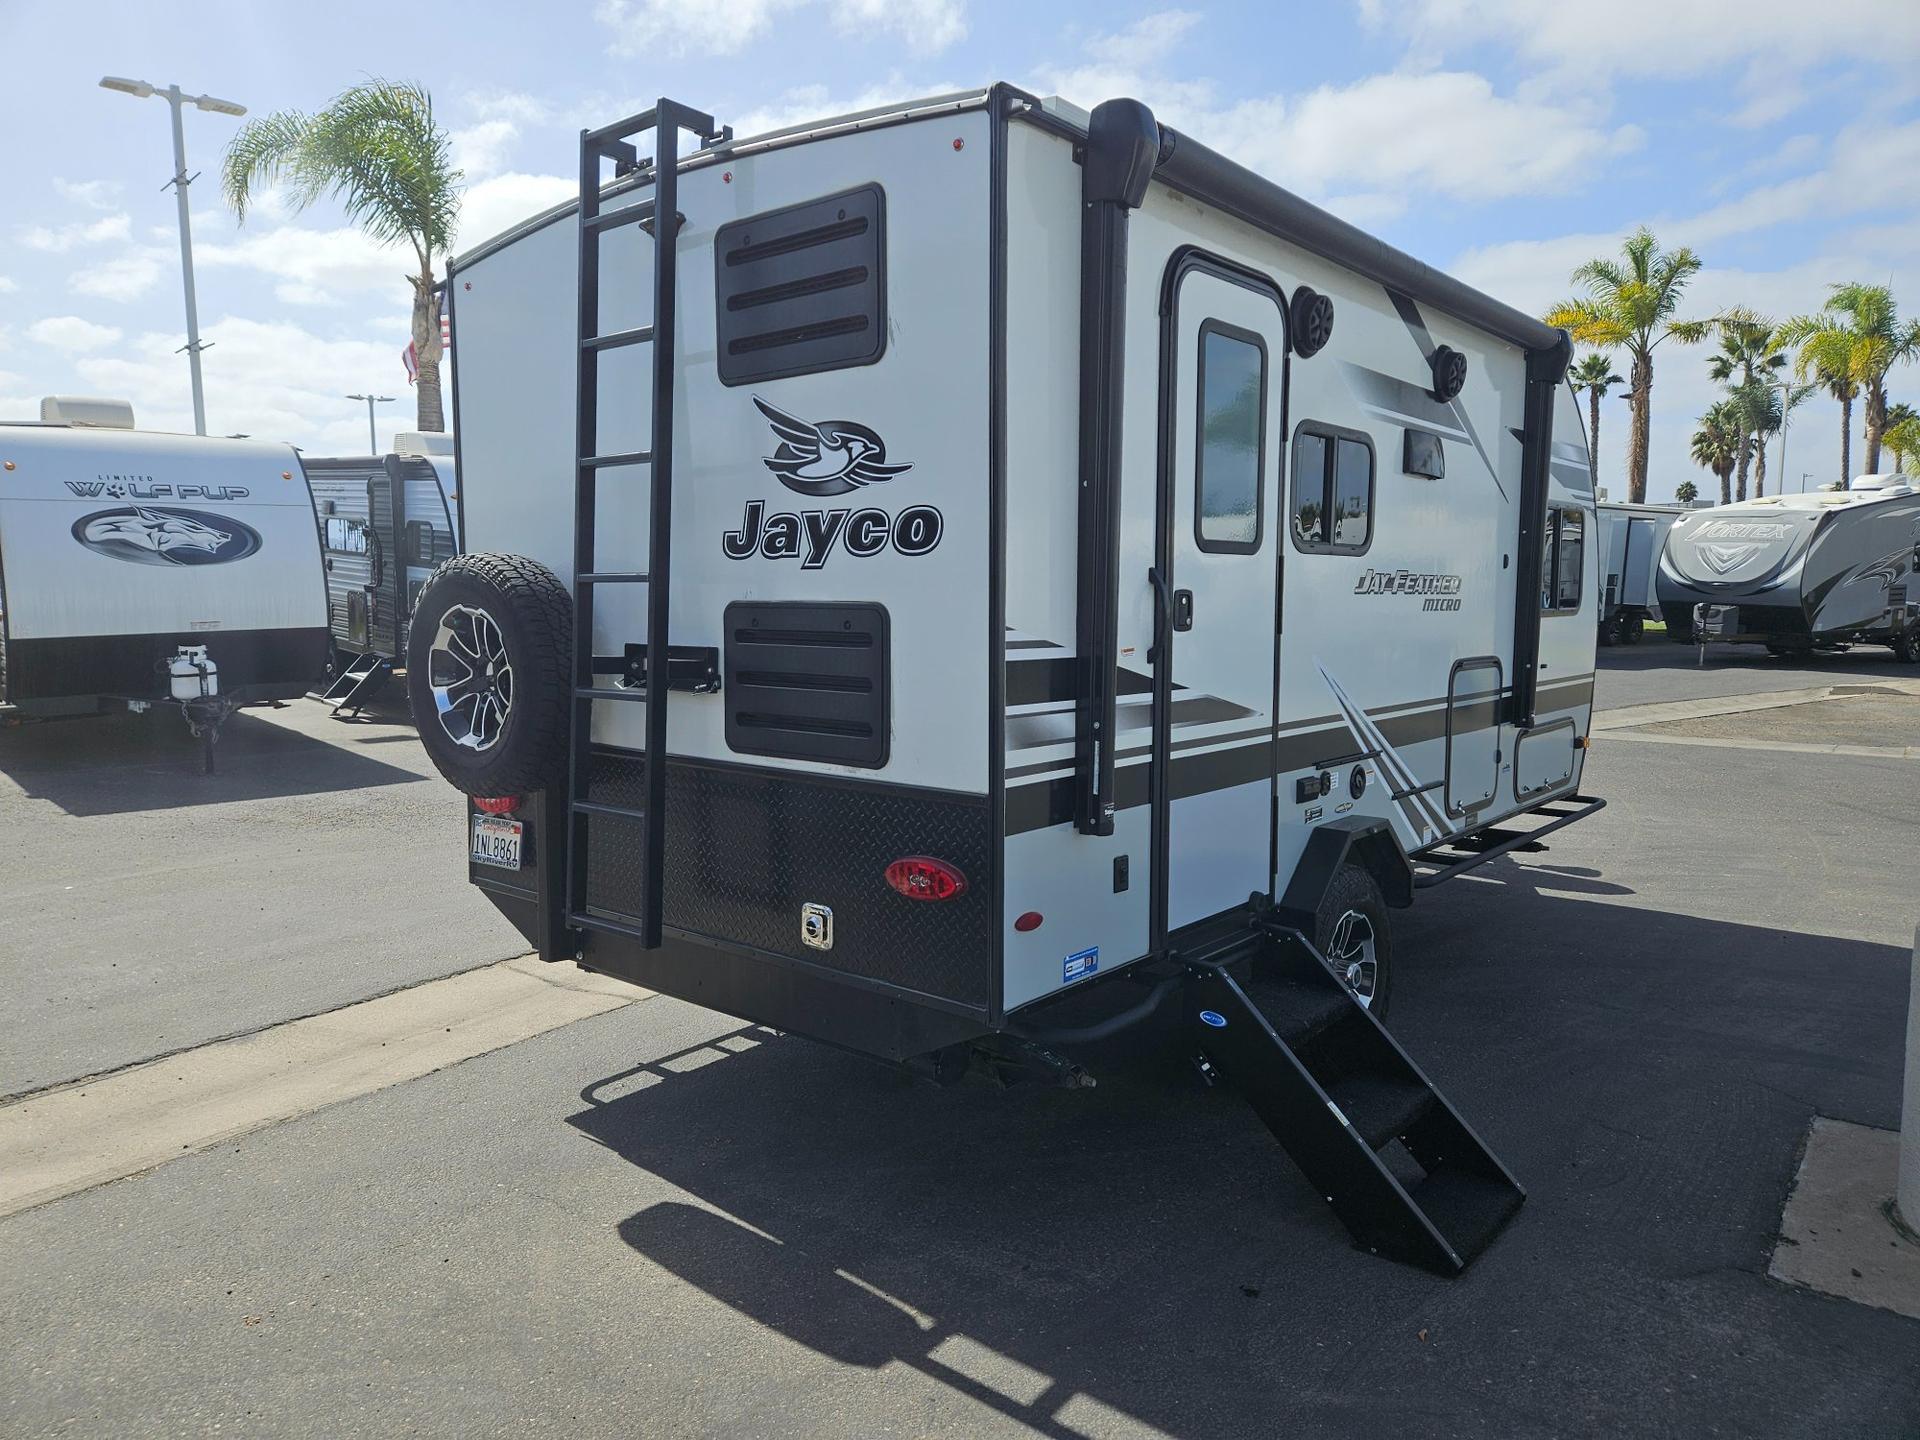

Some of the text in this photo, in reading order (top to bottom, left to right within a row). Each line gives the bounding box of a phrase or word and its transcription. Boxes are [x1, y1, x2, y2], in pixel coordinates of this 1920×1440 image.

[97, 474, 154, 482] LIMITED
[176, 484, 250, 501] PUP
[722, 499, 945, 570] Jayco
[1684, 520, 1794, 541] VORTEX
[1390, 569, 1462, 595] FEATHER
[1422, 598, 1462, 612] MICRO
[474, 833, 518, 862] 1NL8861
[472, 853, 518, 868] SkyRiverRV
